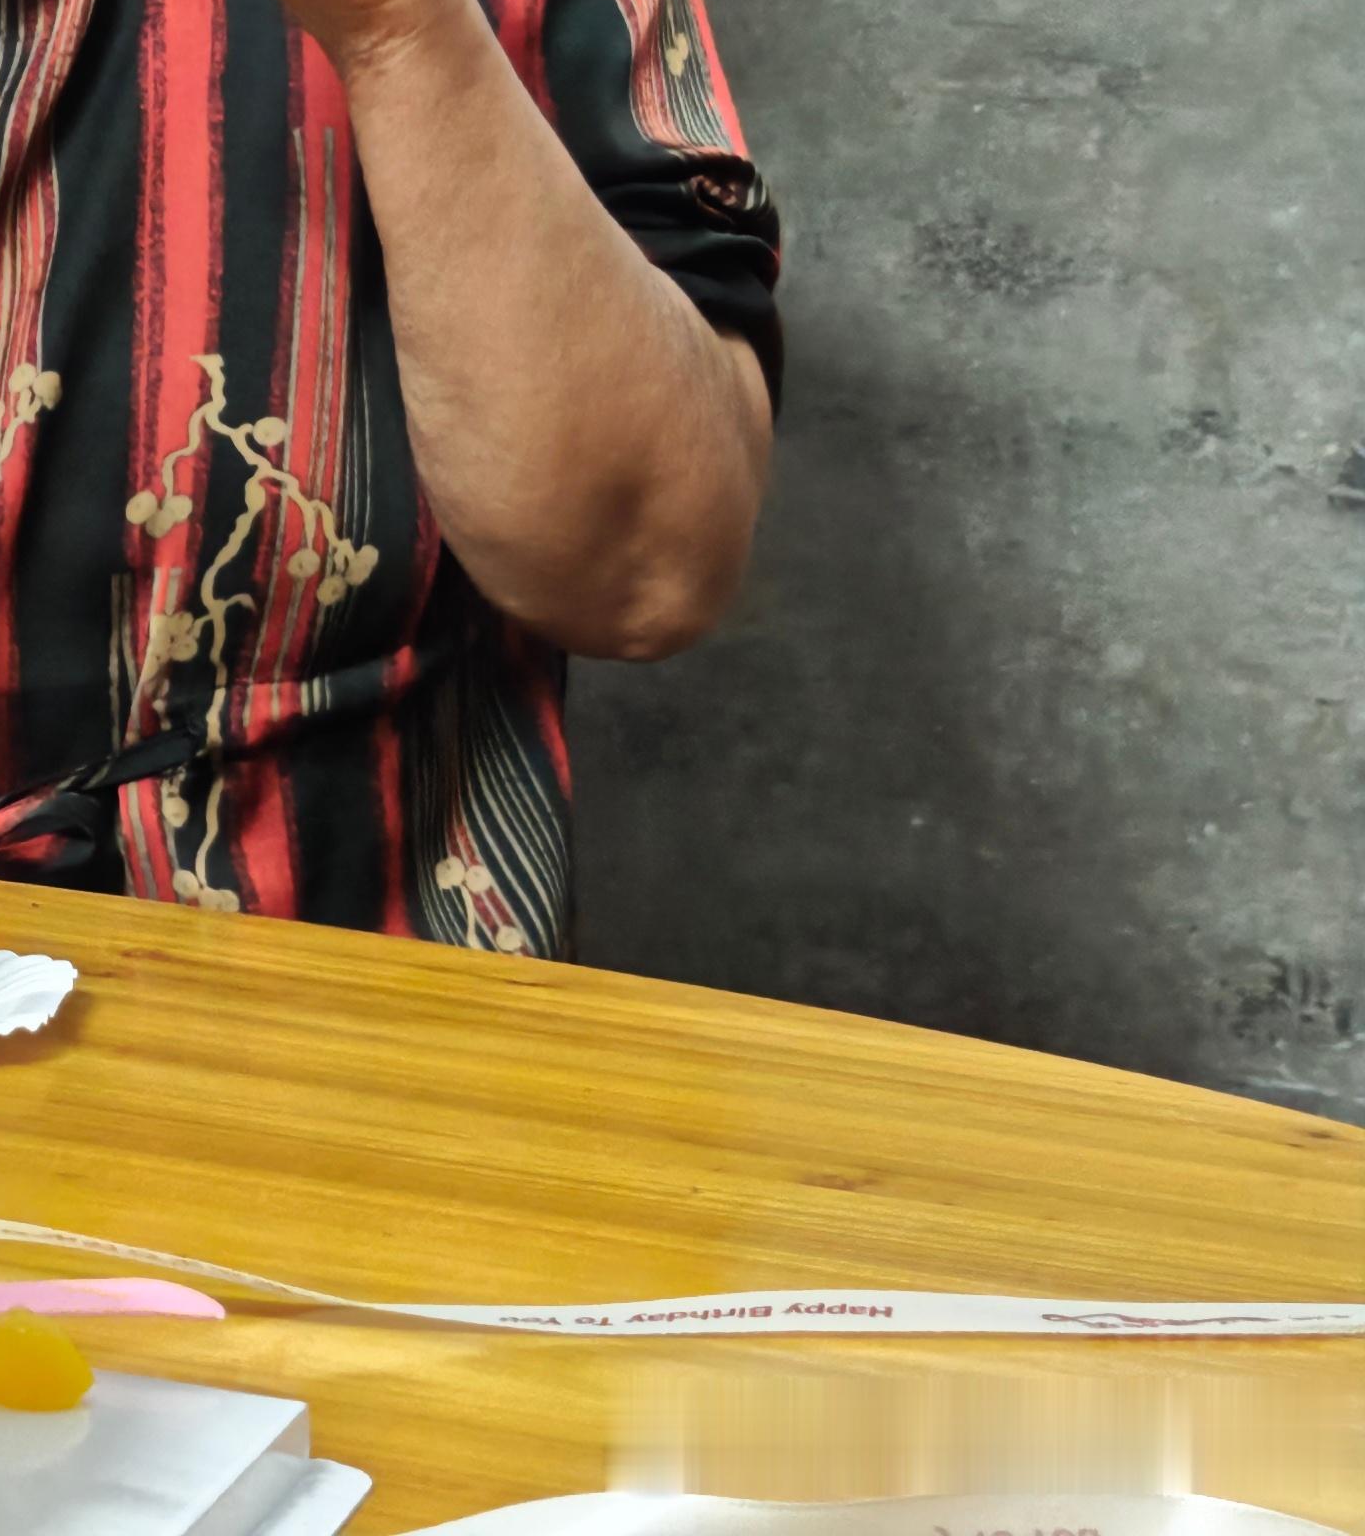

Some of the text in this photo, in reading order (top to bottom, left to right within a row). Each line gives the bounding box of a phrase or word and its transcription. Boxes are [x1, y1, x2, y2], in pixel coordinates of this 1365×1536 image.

[625, 1304, 774, 1324] Birthday
[783, 1301, 894, 1319] Happy
[574, 1315, 613, 1327] To
